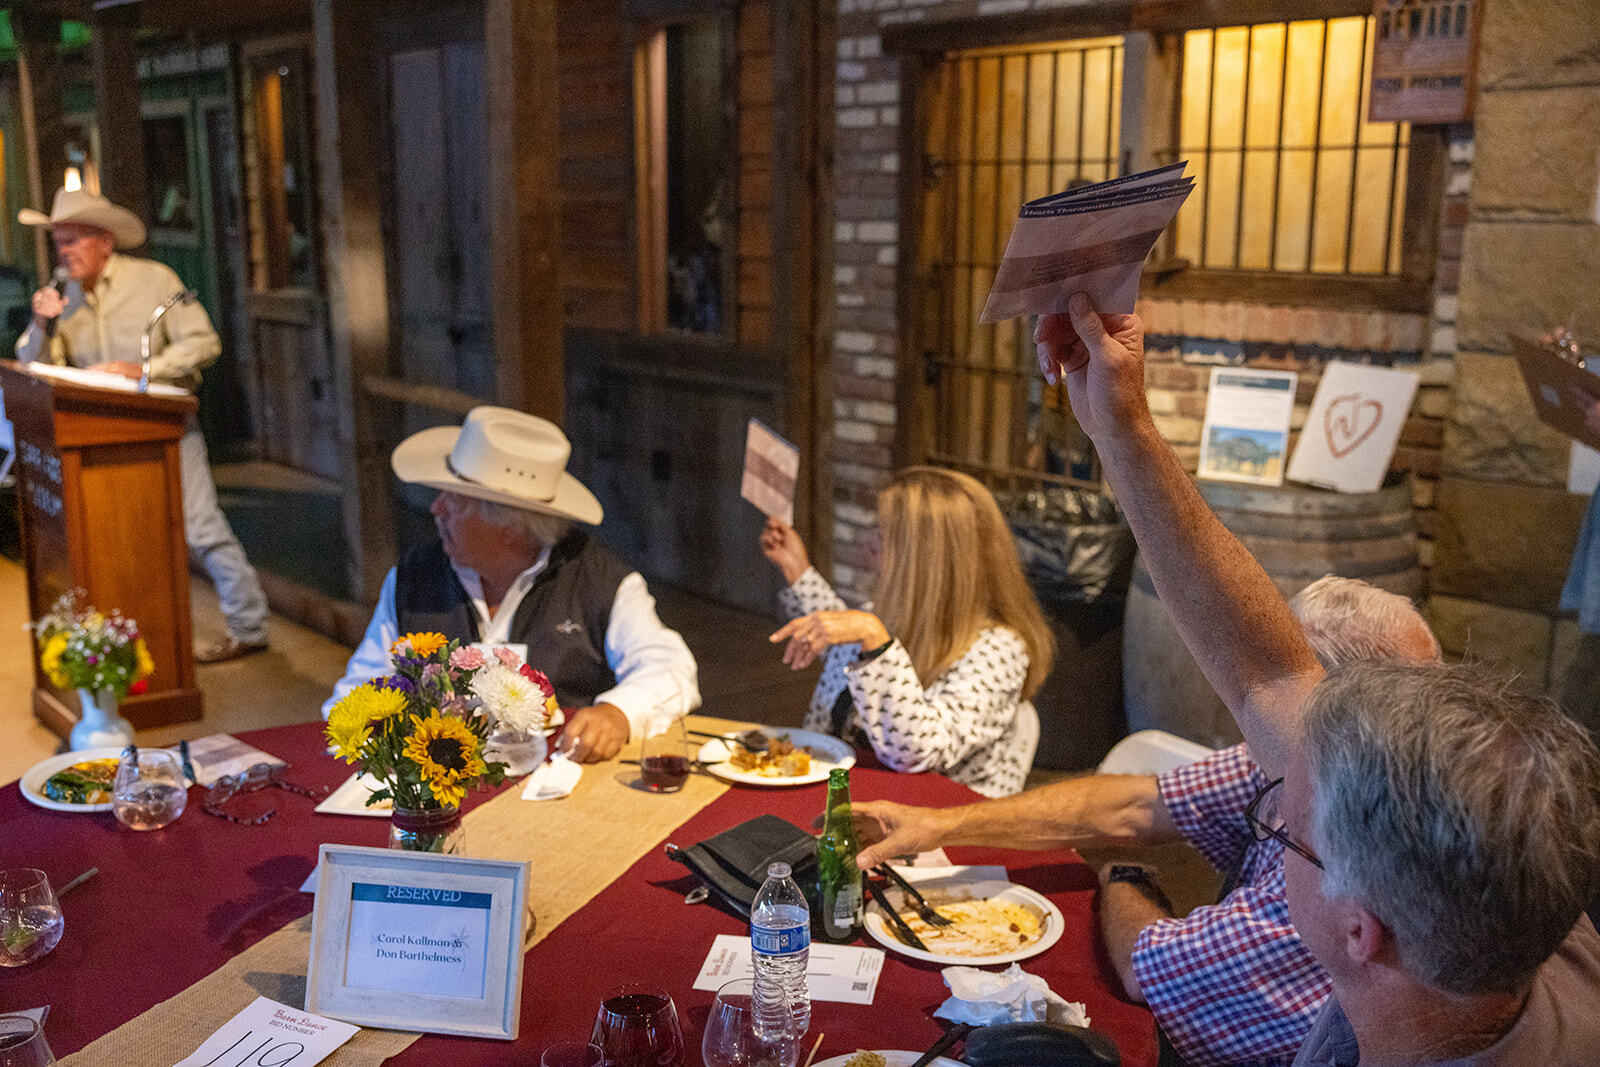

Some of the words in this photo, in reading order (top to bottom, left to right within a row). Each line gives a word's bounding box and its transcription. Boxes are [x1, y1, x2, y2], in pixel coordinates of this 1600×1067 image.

[386, 885, 462, 903] RESERVED
[377, 933, 406, 945] Carol
[376, 948, 398, 960] Don
